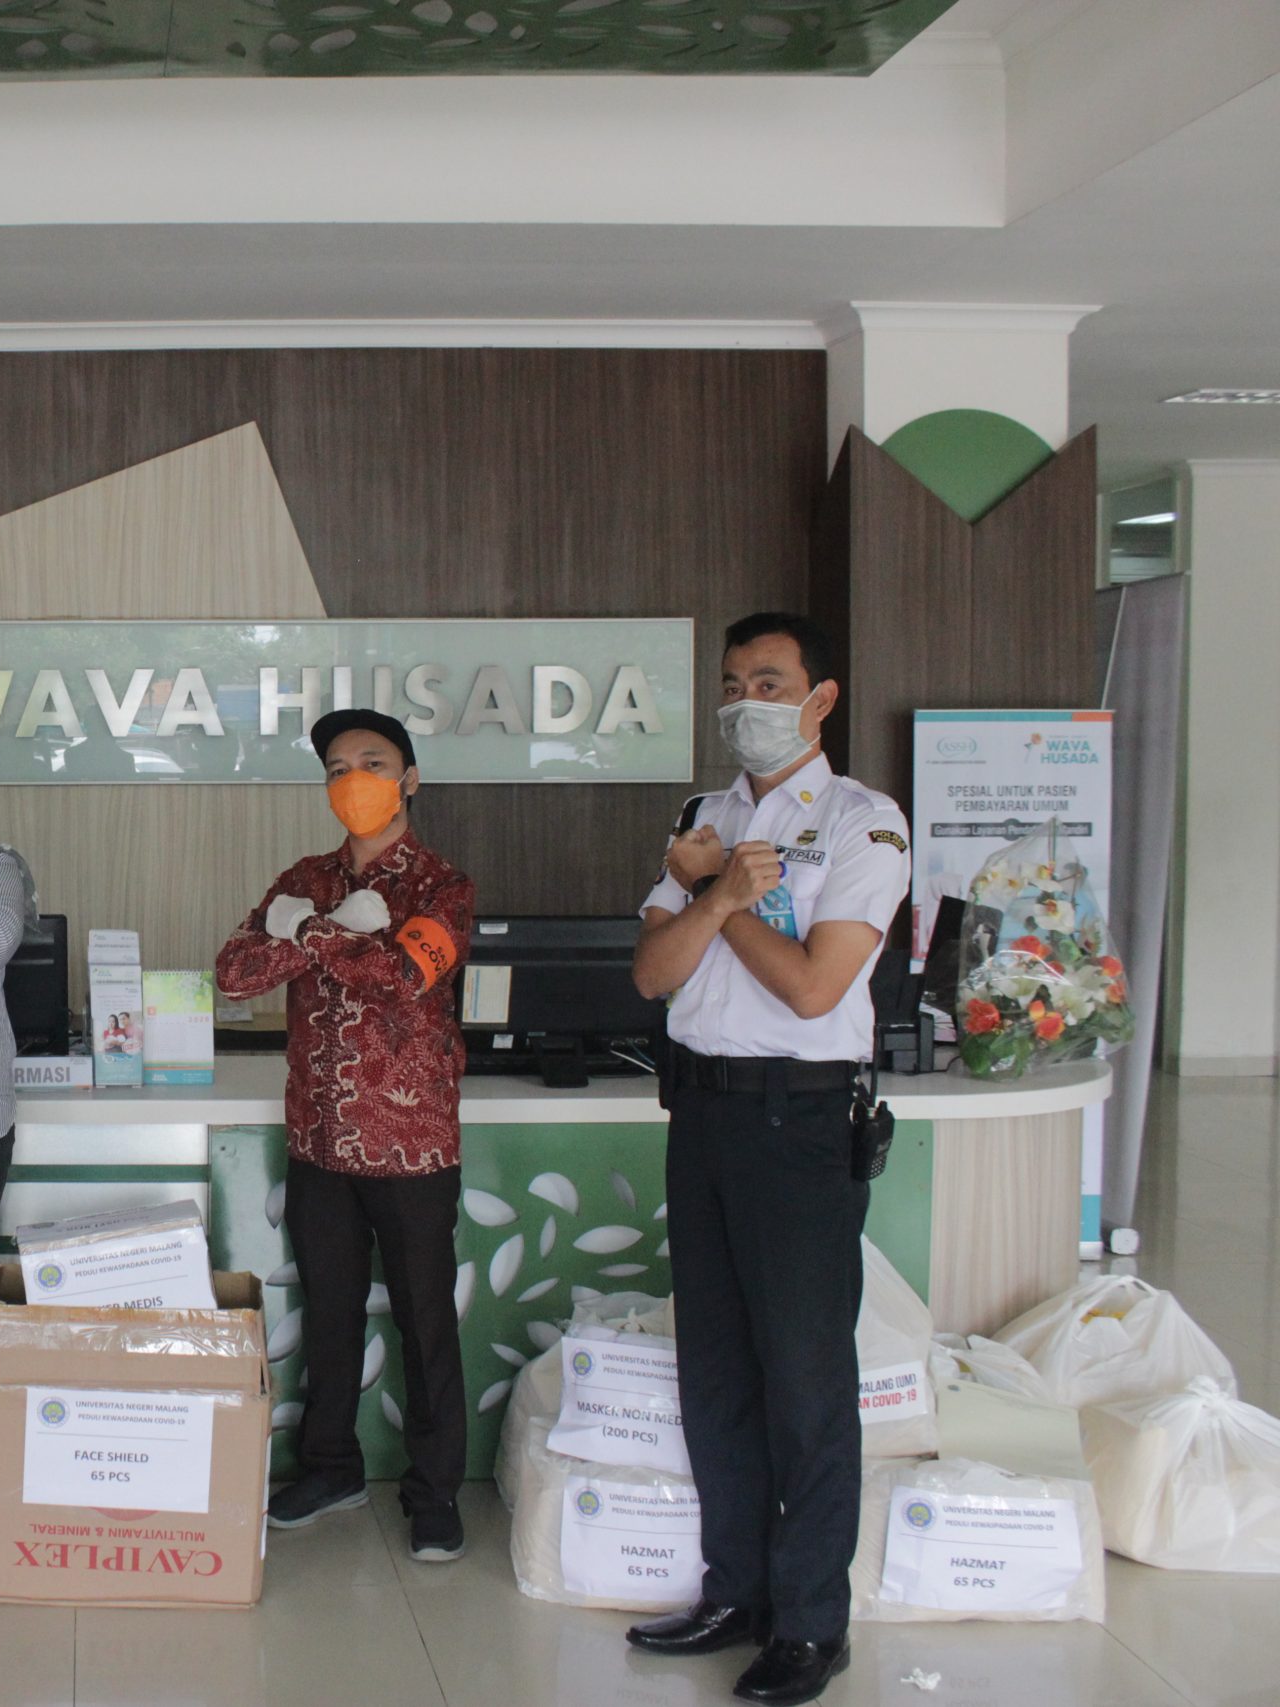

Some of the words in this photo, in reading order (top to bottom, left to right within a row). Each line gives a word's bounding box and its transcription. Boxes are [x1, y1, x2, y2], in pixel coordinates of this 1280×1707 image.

[260, 664, 664, 735] HUSADA
[1046, 741, 1090, 751] WAVA
[1041, 753, 1098, 764] HUSADA
[948, 786, 993, 797] SPESIAL
[997, 786, 1034, 796] UNTUK
[1038, 786, 1077, 796] PASIEN
[956, 801, 1028, 811] PEMBAYARAN
[1033, 800, 1068, 811] UMUM
[786, 849, 822, 862] ATPAM
[421, 943, 441, 974] COV
[70, 1253, 119, 1265] UNIVERSITAS
[120, 1248, 147, 1257] NEGERI
[149, 1242, 182, 1253] MALANG
[75, 1269, 98, 1277] PEDULI
[151, 1255, 182, 1264] COVID-19
[125, 1297, 163, 1309] MEDIS
[602, 1354, 650, 1365] UNIVERSITAS
[896, 1373, 916, 1388] (UM)
[873, 1388, 916, 1407] COVID-19
[76, 1401, 124, 1410] UNIVERSITAS
[155, 1405, 188, 1413] MALANG
[102, 1415, 153, 1423] KEWASPADAAN
[622, 1408, 650, 1421] NON
[603, 1425, 628, 1438] (200
[632, 1431, 658, 1445] PCS)
[75, 1450, 103, 1461] FACE
[107, 1452, 149, 1463] SHIELD
[91, 1471, 105, 1480] 65
[109, 1472, 130, 1482] PCS
[609, 1494, 658, 1504] UNIVERSITAS
[612, 1507, 635, 1515] PEDULI
[943, 1506, 992, 1516] UNIVERSITAS
[1024, 1510, 1055, 1518] MALANG
[30, 1524, 90, 1536] MINERAL
[96, 1527, 104, 1536] &
[108, 1528, 205, 1542] MULTIVITAMIN
[621, 1545, 675, 1559] HAZMAT
[14, 1541, 223, 1576] CAVIPLEX
[951, 1558, 1006, 1570] HAZMAT
[628, 1566, 642, 1576] 65
[646, 1568, 669, 1578] PCS
[954, 1577, 968, 1586] 65
[972, 1578, 995, 1588] PCS
